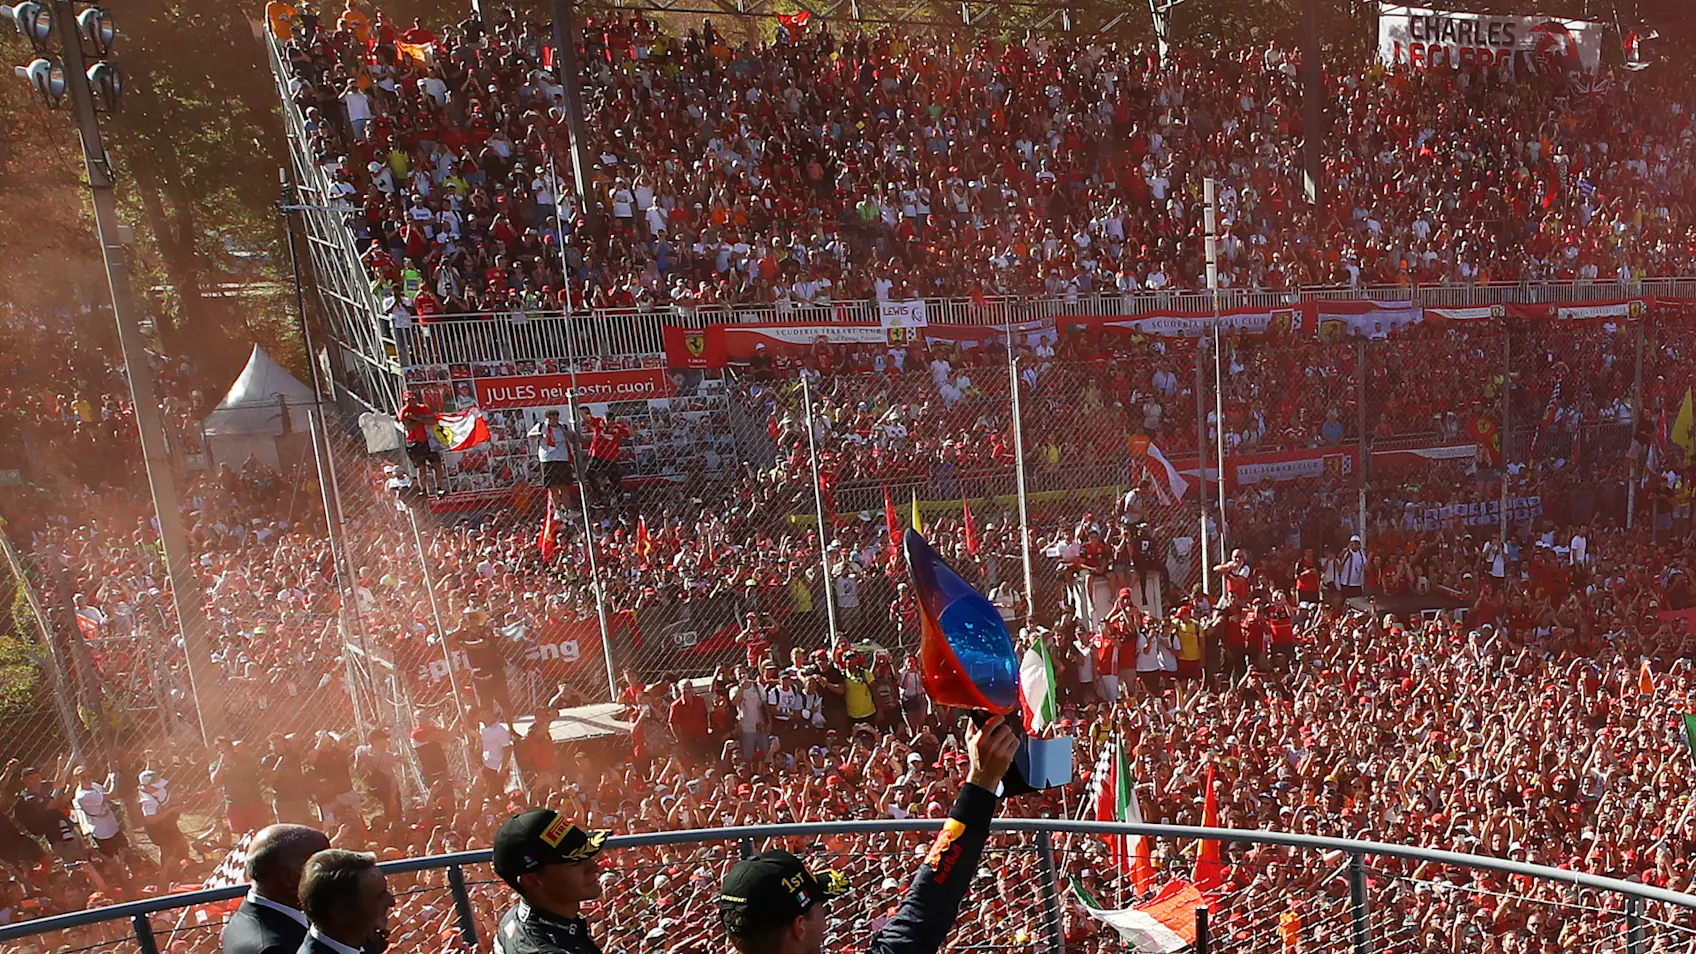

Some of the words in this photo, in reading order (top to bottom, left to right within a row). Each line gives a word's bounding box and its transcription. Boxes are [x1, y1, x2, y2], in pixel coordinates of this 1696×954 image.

[1410, 16, 1516, 46] CHARLES
[883, 306, 908, 316] LEWIS
[776, 328, 819, 336] SCUDERIA
[1152, 321, 1198, 329] SCUDERIA
[1242, 317, 1265, 325] CLUB
[486, 385, 536, 404] JULES
[540, 383, 563, 398] nei
[568, 380, 612, 397] ostri
[618, 378, 655, 394] cuori
[545, 815, 571, 842] PIRE
[782, 872, 804, 894] 1ST
